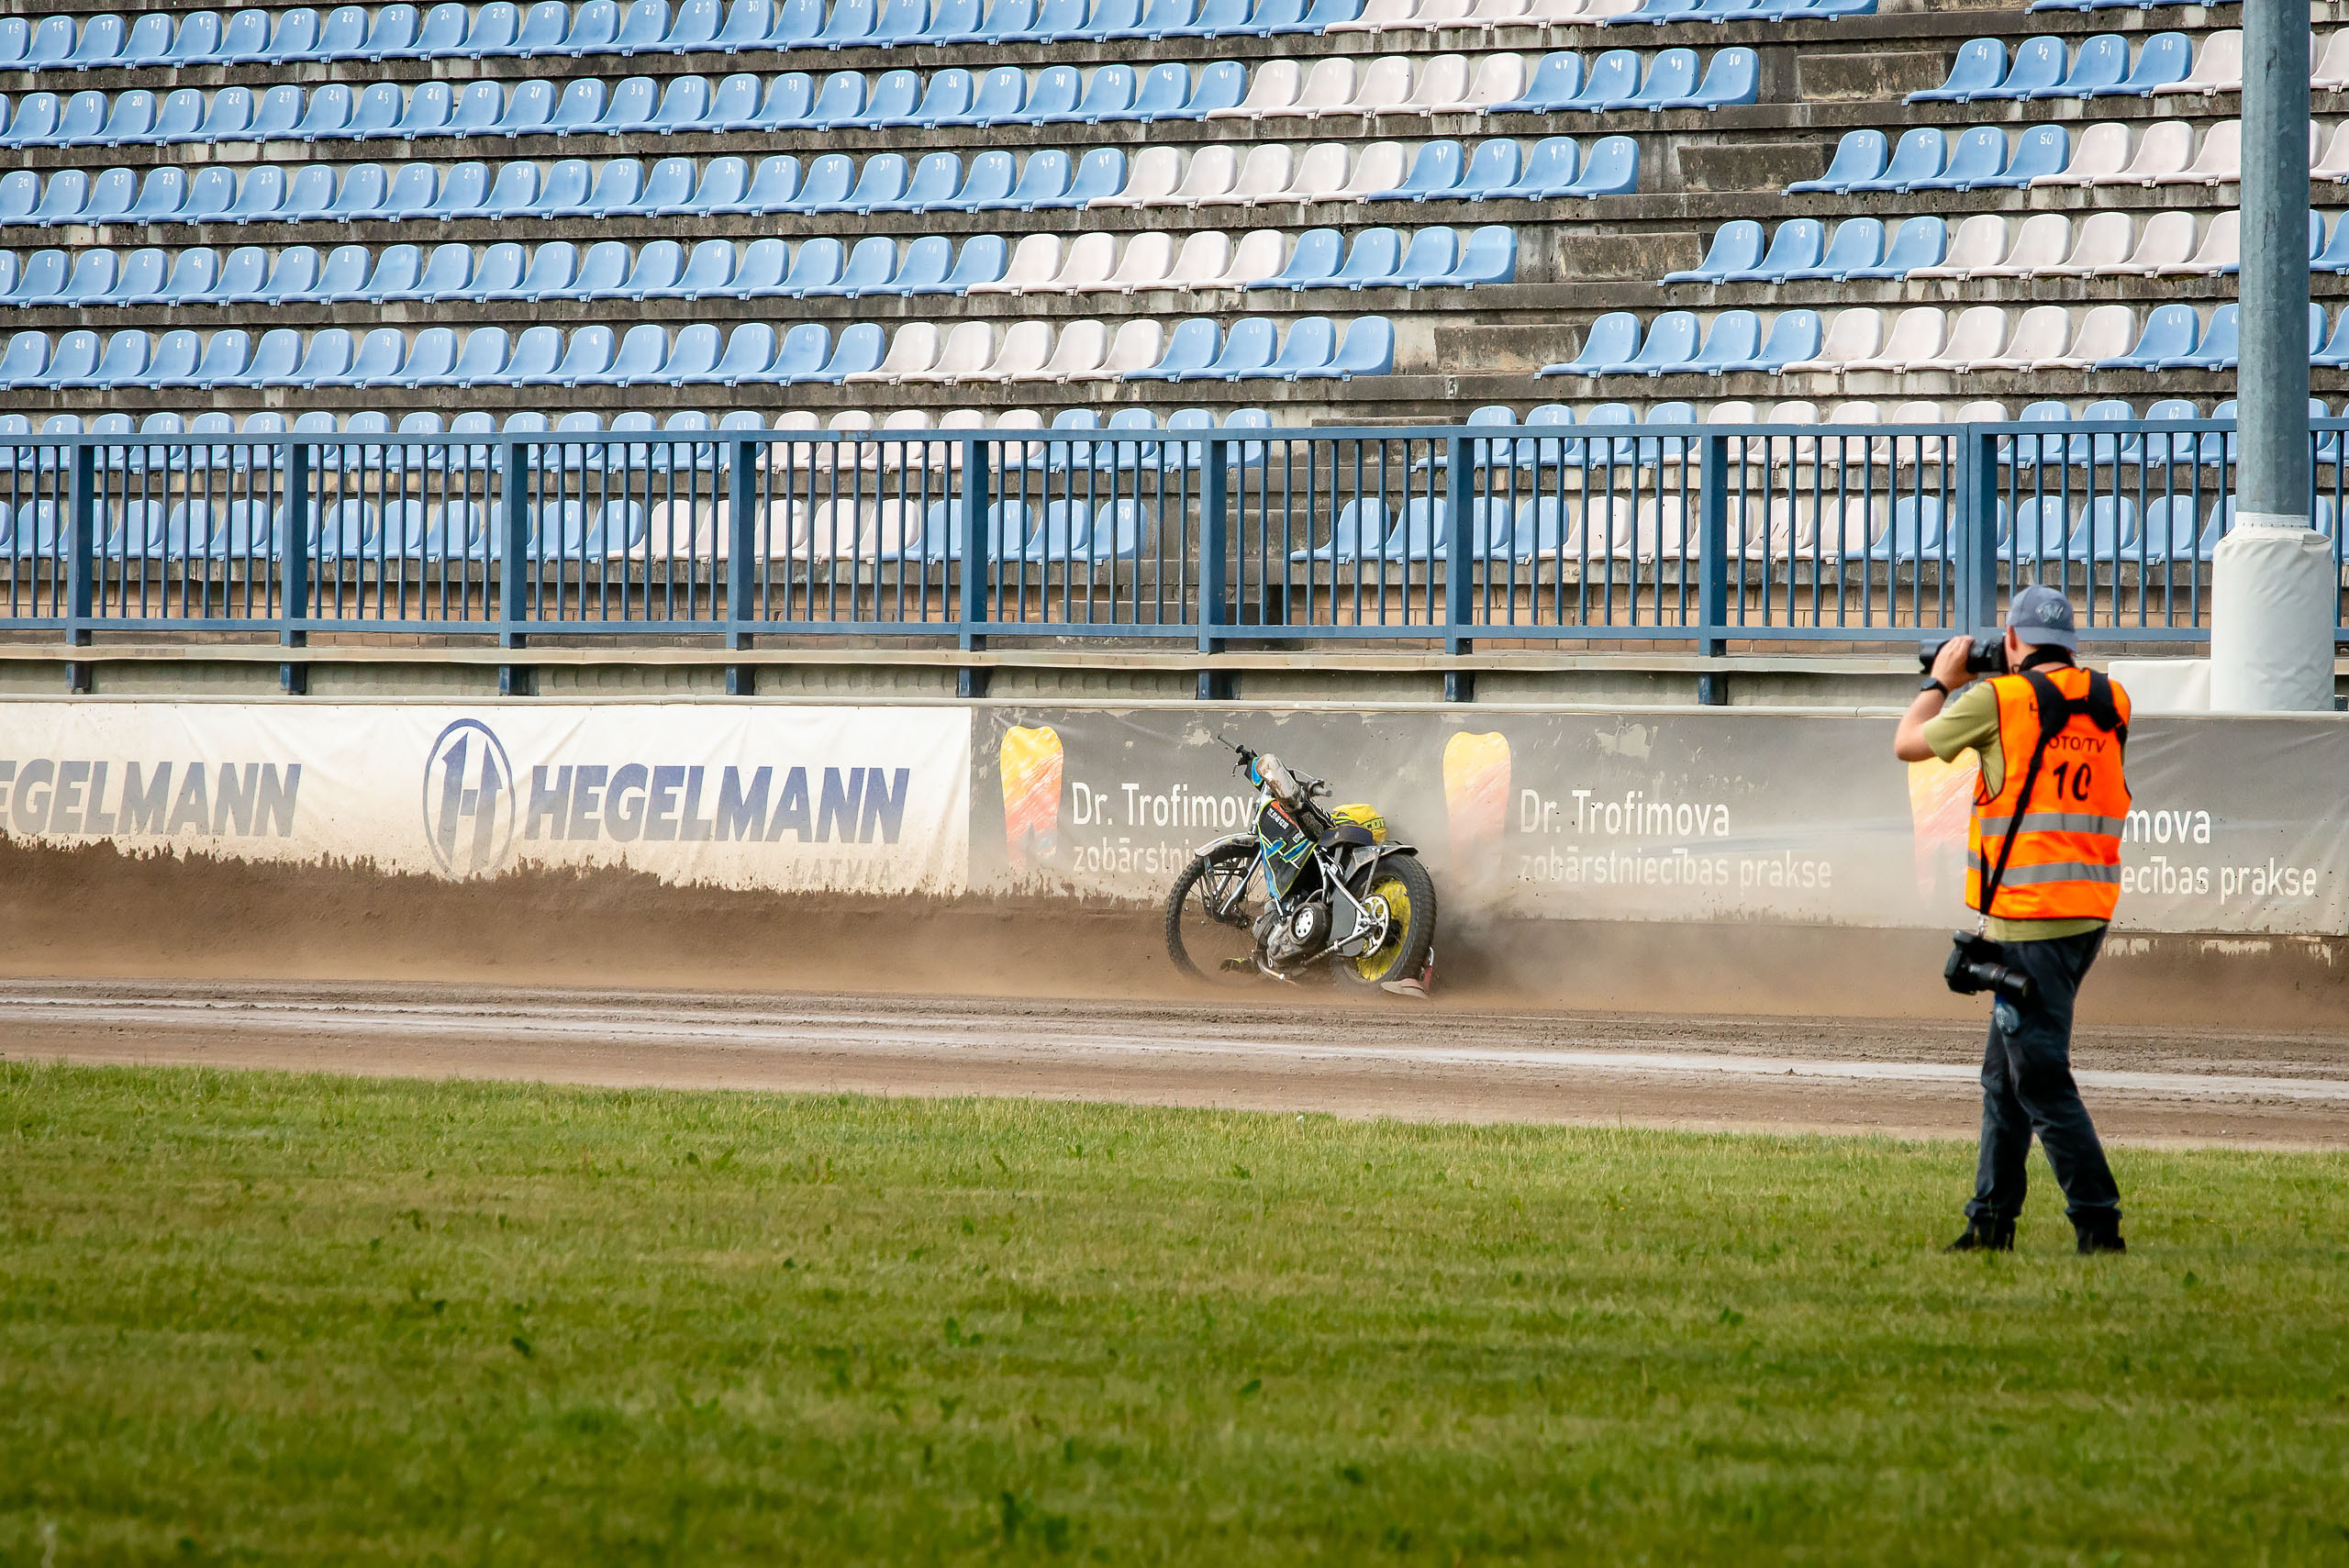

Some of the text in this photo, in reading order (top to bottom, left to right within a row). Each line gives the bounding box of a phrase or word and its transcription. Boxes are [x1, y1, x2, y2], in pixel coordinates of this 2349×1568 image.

[101, 20, 114, 30] 17
[2099, 40, 2111, 57] 51
[1554, 60, 1568, 70] 47
[1670, 57, 1682, 71] 49
[948, 74, 958, 88] 36
[999, 74, 1011, 87] 37
[1163, 69, 1173, 82] 40
[1219, 70, 1229, 79] 41
[630, 83, 644, 95] 30
[684, 81, 696, 94] 31
[736, 81, 747, 92] 32
[840, 78, 850, 89] 34
[427, 88, 440, 100] 26
[477, 88, 489, 99] 27
[578, 85, 592, 97] 29
[85, 97, 95, 114] 19
[132, 95, 143, 107] 20
[179, 95, 191, 106] 21
[228, 93, 240, 106] 22
[2040, 133, 2054, 146] 50
[1098, 154, 1109, 168] 41
[1436, 146, 1449, 163] 47
[211, 172, 222, 184] 24
[517, 168, 529, 180] 30
[2048, 736, 2107, 753] OTO/TV
[2054, 761, 2091, 802] 10
[524, 763, 910, 844] HEGELMANN
[1072, 782, 1113, 826] Dr.
[1121, 783, 1254, 828] Trofimov
[1520, 788, 1731, 836] Dr. Trofimova
[792, 858, 896, 884] LATVIA
[1519, 846, 1832, 896] zobārstniecības prakse
[2221, 857, 2318, 906] prakse
